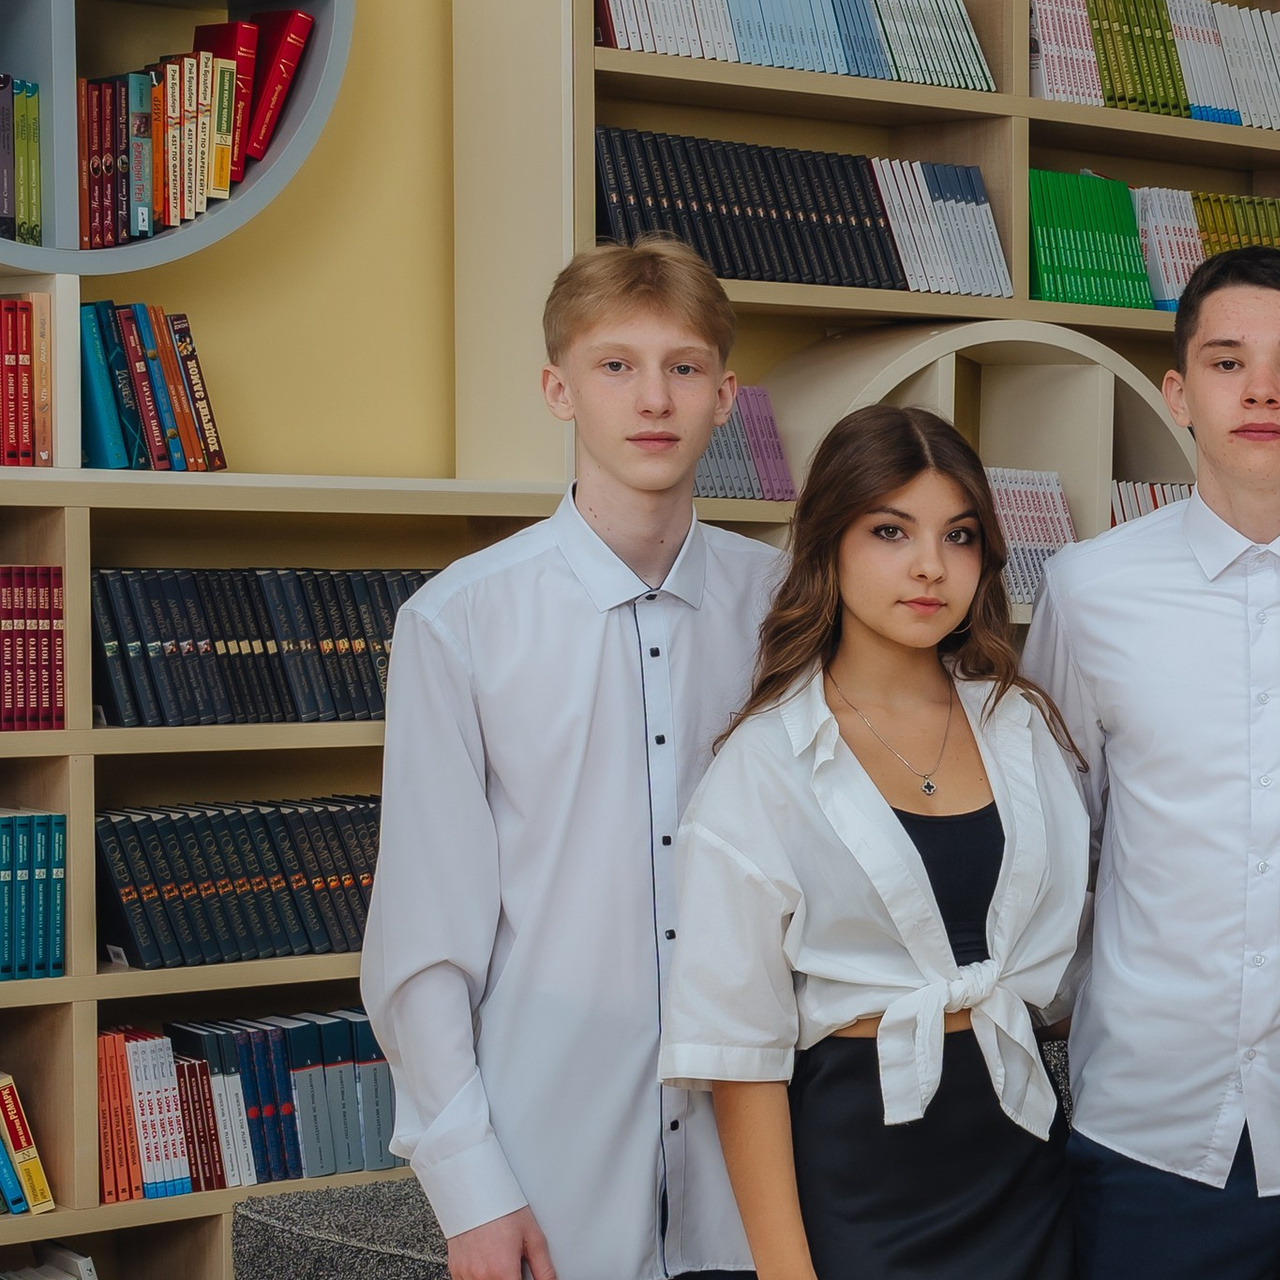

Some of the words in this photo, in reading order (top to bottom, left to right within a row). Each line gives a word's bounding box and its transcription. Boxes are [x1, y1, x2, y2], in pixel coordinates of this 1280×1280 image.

[29, 669, 37, 707] ВИКТОР
[105, 836, 129, 882] ГОМЕР
[125, 835, 150, 881] ГОМЕР
[275, 826, 299, 870] ГОМЕР
[310, 825, 334, 870] ГОМЕР
